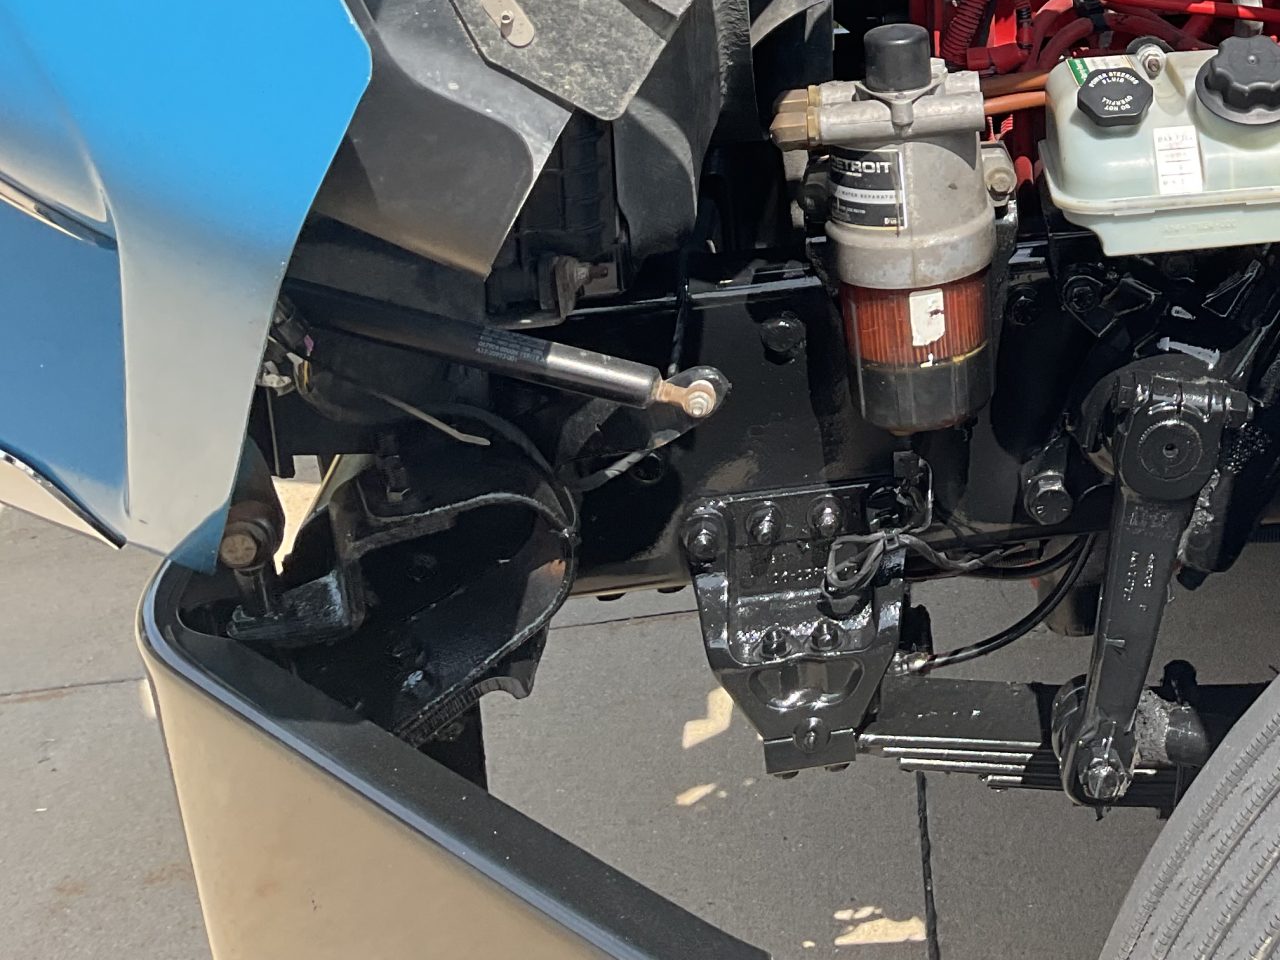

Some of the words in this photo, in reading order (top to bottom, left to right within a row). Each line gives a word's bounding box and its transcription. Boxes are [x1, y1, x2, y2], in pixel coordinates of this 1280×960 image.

[1088, 73, 1108, 88] POWER
[1108, 71, 1140, 85] STEERING
[1101, 95, 1133, 106] OVERFILL
[1120, 103, 1131, 111] DO
